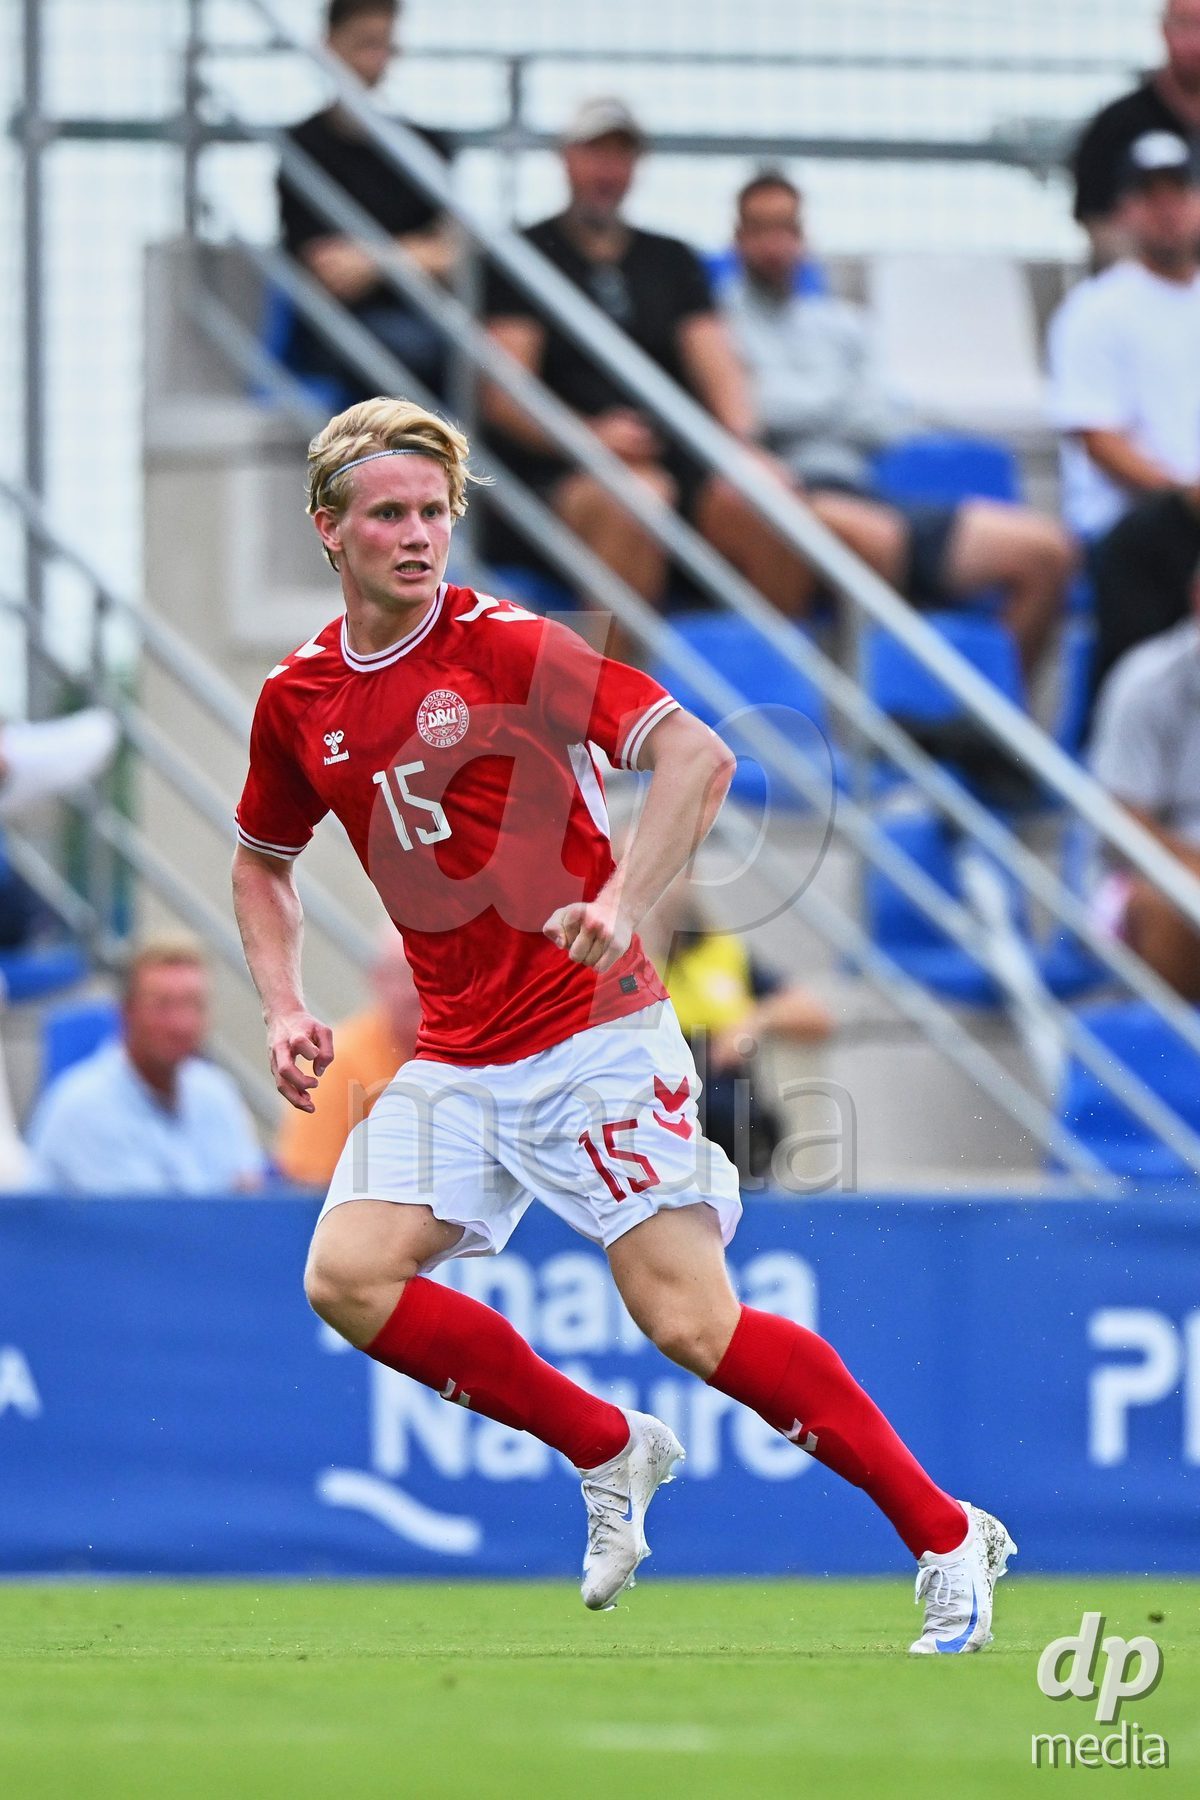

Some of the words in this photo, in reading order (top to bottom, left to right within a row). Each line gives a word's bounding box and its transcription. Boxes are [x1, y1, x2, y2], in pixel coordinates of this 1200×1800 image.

[427, 706, 459, 729] DBU
[457, 703, 468, 736] UNION
[434, 734, 458, 746] 1889
[323, 749, 350, 766] hummel
[372, 760, 453, 851] 15
[578, 1118, 661, 1204] 15
